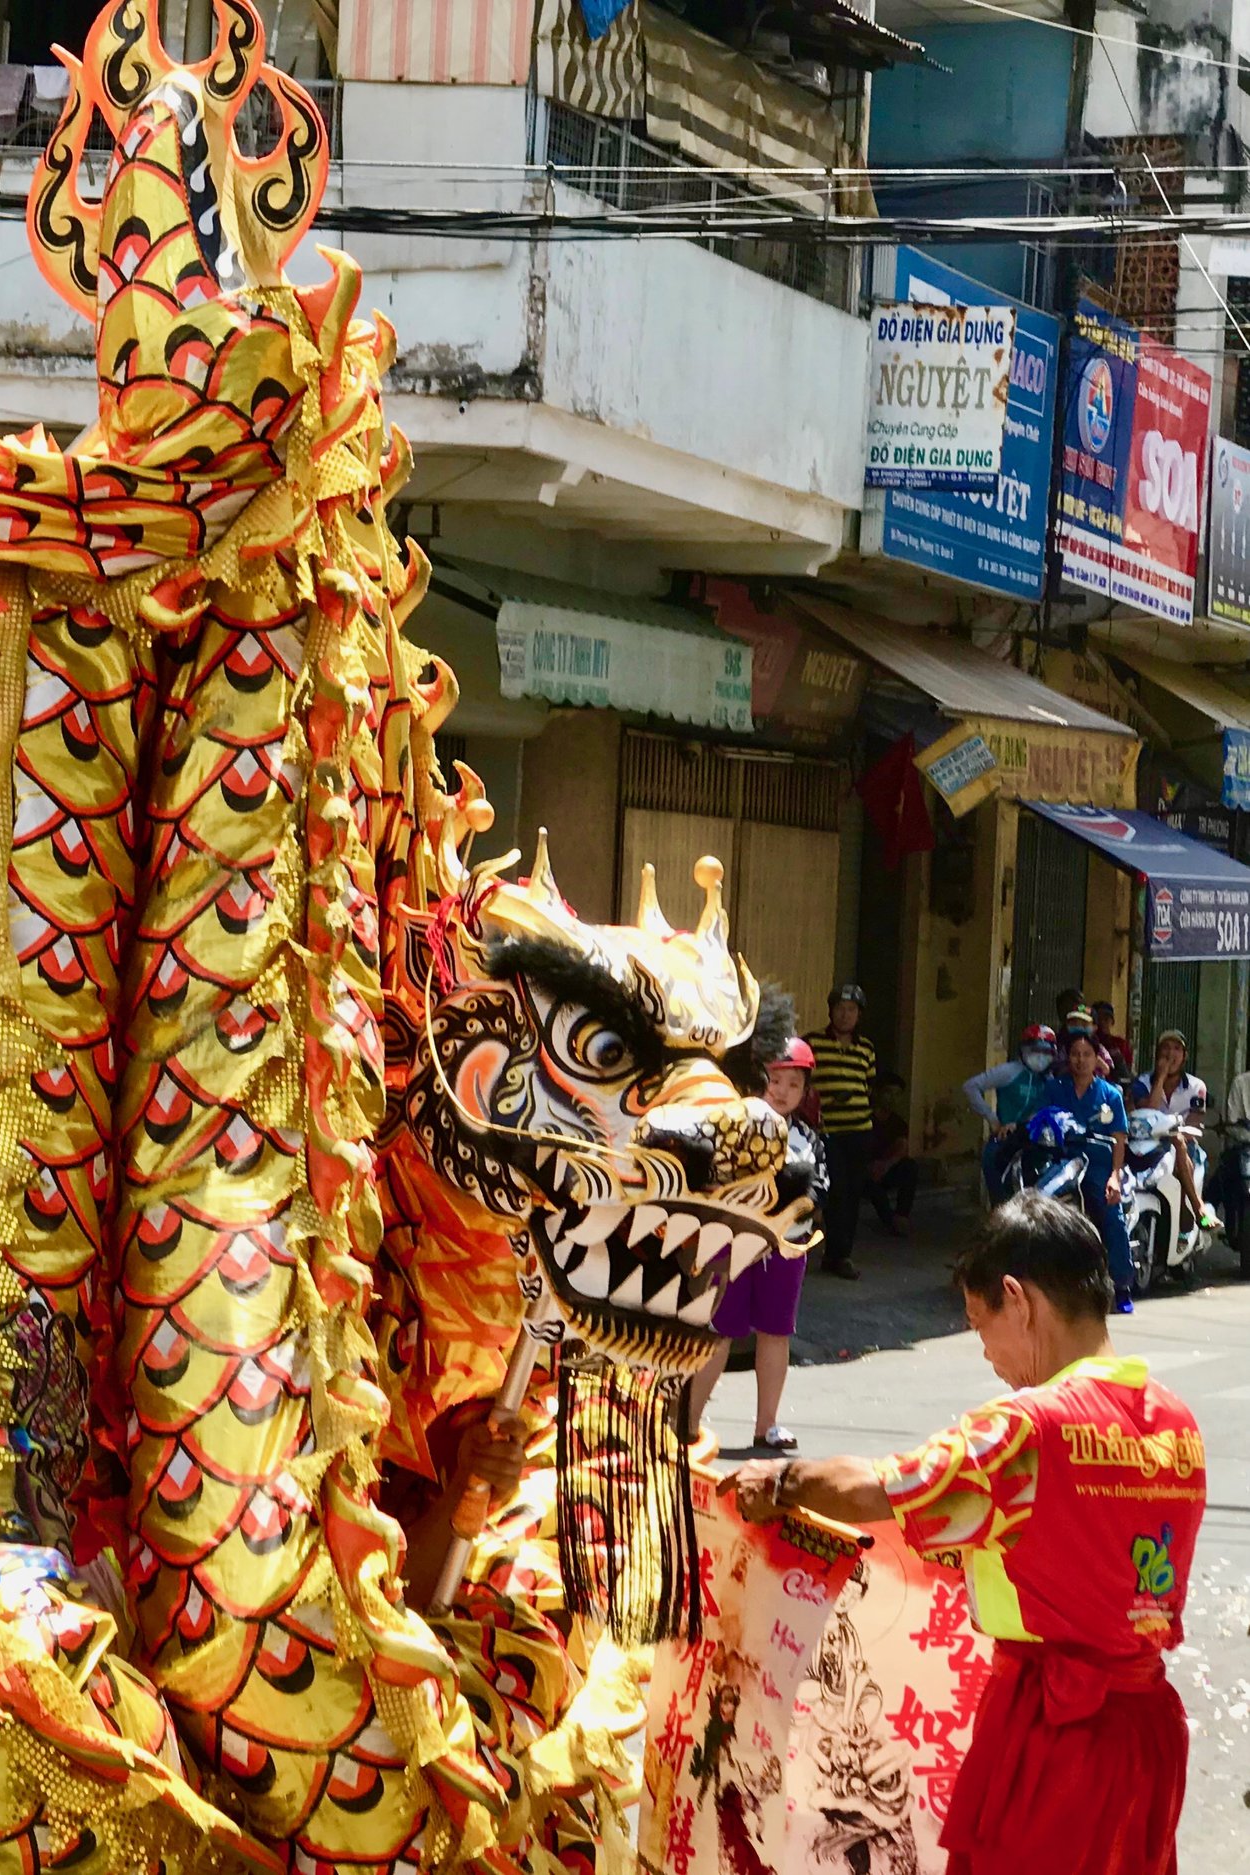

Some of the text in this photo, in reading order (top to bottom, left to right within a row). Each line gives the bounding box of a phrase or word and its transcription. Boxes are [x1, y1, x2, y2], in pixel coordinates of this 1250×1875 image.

[878, 312, 1004, 349] ĐỒ ĐIỆN GIA DỤNG
[876, 356, 991, 418] NGUYỆT
[872, 419, 958, 440] Chuyên Cung Cấp
[870, 441, 993, 471] ĐỒ ĐIỆN GIA DỤNG
[1139, 429, 1197, 535] SOA
[1217, 909, 1240, 952] SOA
